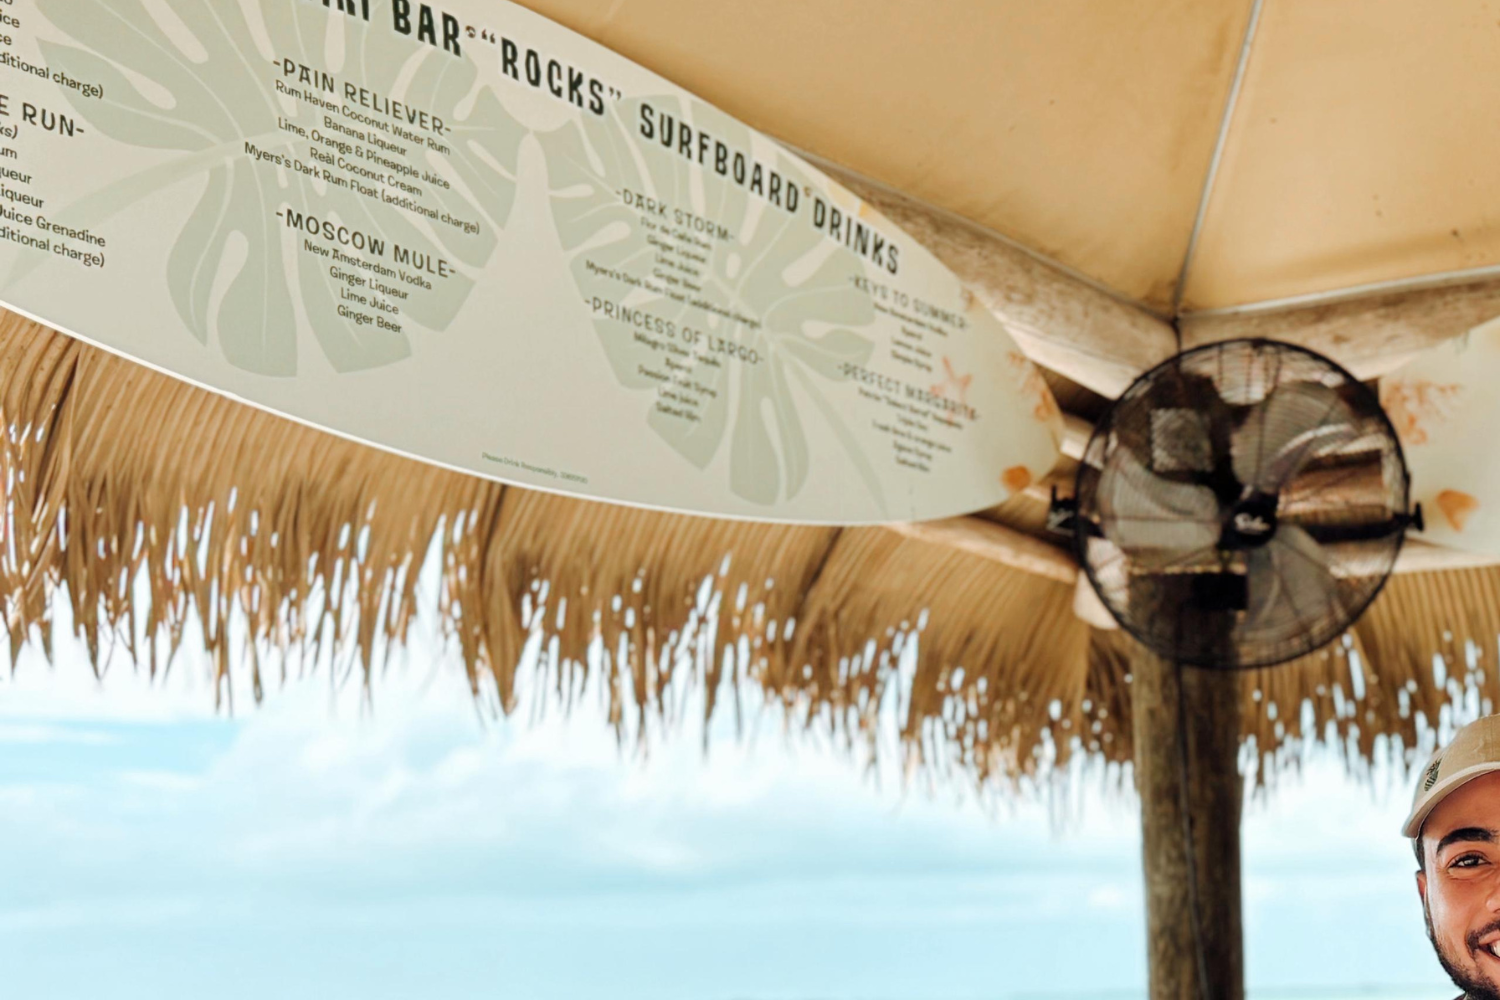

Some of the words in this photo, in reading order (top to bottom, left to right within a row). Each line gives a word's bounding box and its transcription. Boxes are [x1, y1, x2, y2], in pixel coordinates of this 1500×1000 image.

[52, 72, 104, 99] charge)
[22, 101, 84, 137] RUN-
[275, 79, 302, 99] Rum
[304, 89, 340, 114] Haven
[342, 105, 390, 133] Coconut
[392, 123, 425, 146] Water
[427, 137, 451, 156] Rum
[324, 115, 365, 141] Banana
[367, 131, 408, 157] Liqueur
[278, 116, 309, 140] Lime,
[311, 129, 353, 154] Orange
[355, 146, 364, 158] &
[366, 150, 420, 179] Pineapple
[422, 168, 451, 190] Juice
[392, 0, 461, 57] BAR
[639, 102, 799, 214] SURFBOARD
[813, 196, 900, 275] DRINKS
[337, 157, 386, 185] Coconut
[387, 174, 423, 197] Cream
[294, 159, 321, 179] Dark
[322, 170, 349, 189] Rum
[350, 179, 379, 199] Float
[381, 188, 439, 222] (additional
[441, 212, 481, 236] charge)
[36, 215, 106, 247] Grenadine
[53, 242, 105, 268] charge)
[304, 239, 329, 258] New
[332, 248, 397, 279] Amsterdam
[398, 268, 432, 290] Vodka
[329, 265, 367, 287] Ginger
[369, 278, 409, 300] Liqueur
[340, 286, 367, 305] Lime
[369, 296, 400, 315] Juice
[337, 304, 374, 325] Ginger
[376, 315, 402, 334] Beer
